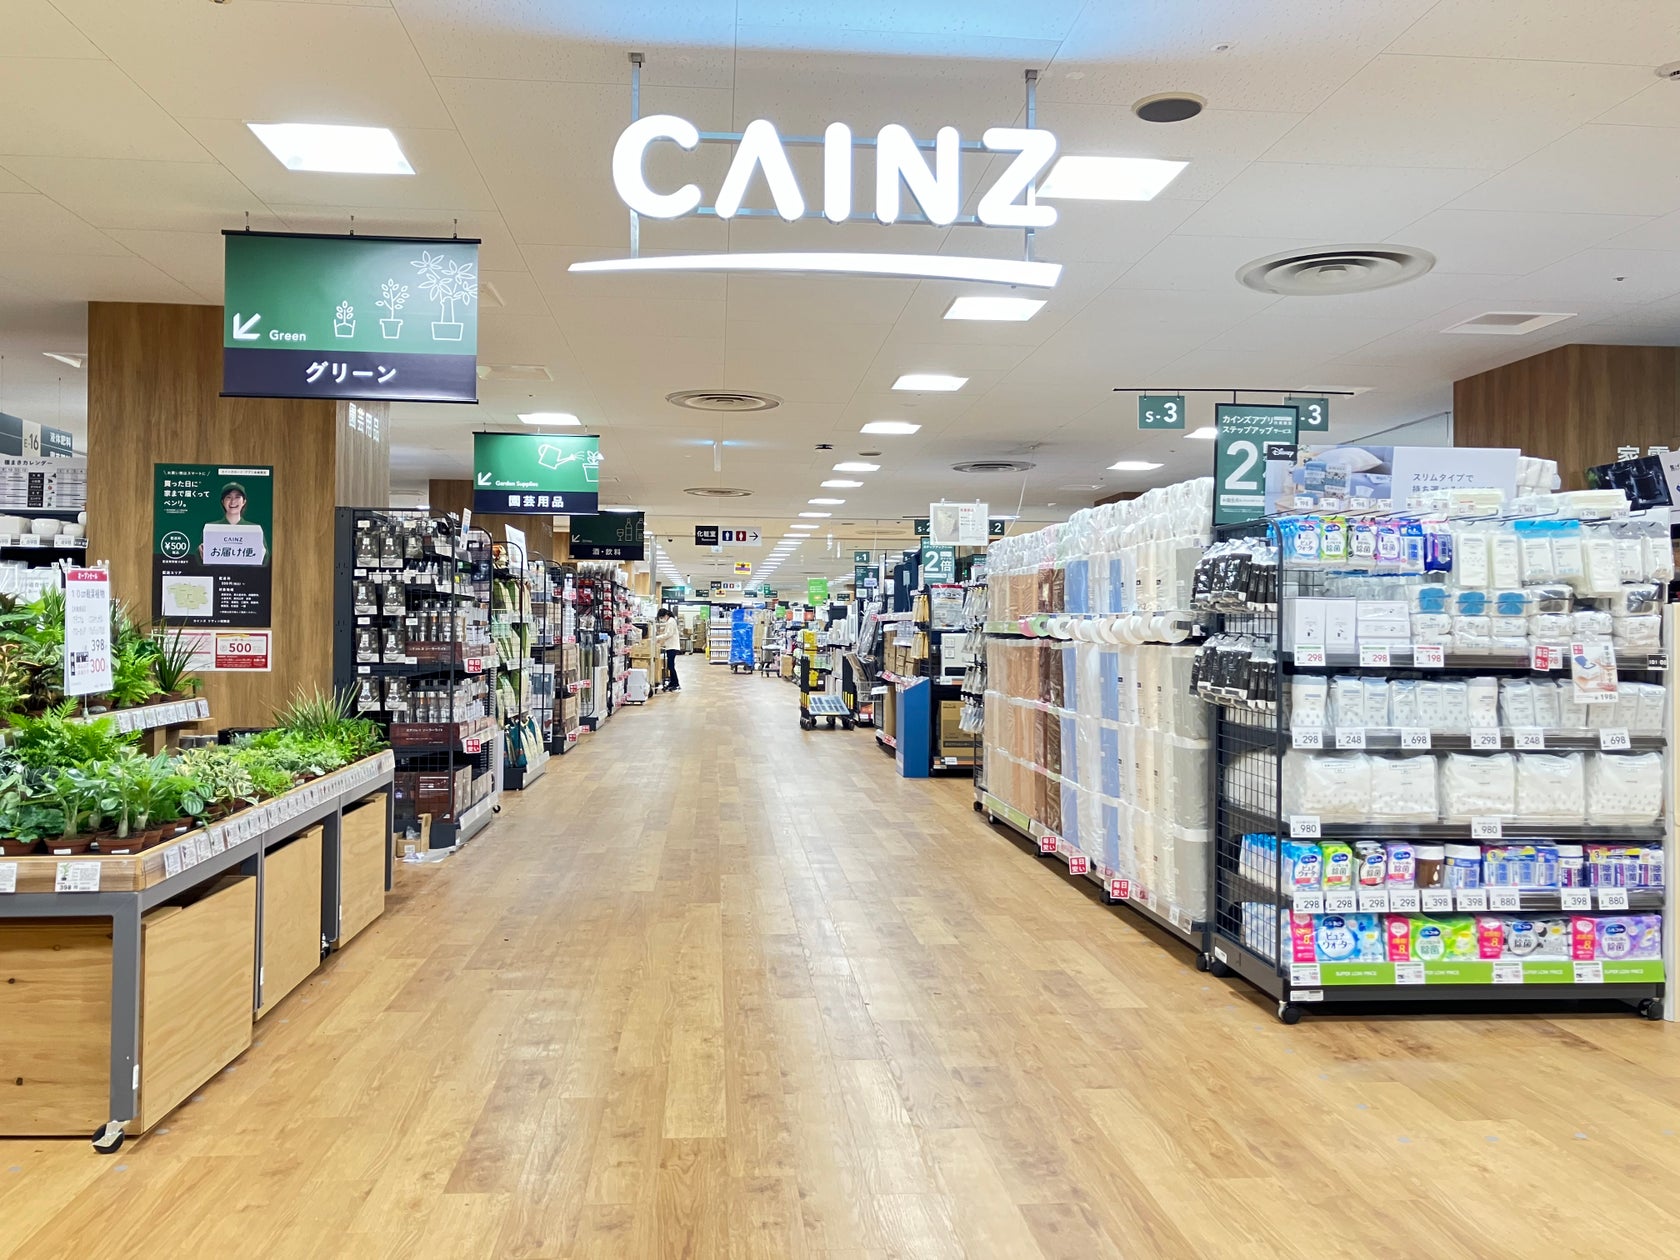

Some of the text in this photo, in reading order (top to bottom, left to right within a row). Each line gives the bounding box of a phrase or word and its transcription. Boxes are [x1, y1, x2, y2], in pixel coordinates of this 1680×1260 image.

[612, 114, 1058, 227] CAINZ
[269, 330, 307, 342] Green
[305, 361, 397, 384] グリーン
[1222, 415, 1274, 425] カインズアプリ
[1271, 447, 1295, 458] Disney
[1225, 440, 1258, 490] 2
[1413, 473, 1474, 482] スリムタイプで
[164, 480, 198, 488] 買った日に
[164, 490, 210, 498] 家まで届くって
[508, 495, 564, 508] 園芸用品
[697, 530, 716, 538] 化粧室
[165, 542, 187, 551] ¥500
[1356, 545, 1370, 553] 除菌
[210, 547, 255, 558] お届け便
[592, 548, 621, 556] 酒・飲料
[91, 639, 105, 651] 398
[229, 643, 252, 653] 500
[1536, 646, 1549, 658] 毎日
[1307, 654, 1323, 662] 298
[1372, 654, 1388, 662] 298
[1427, 654, 1441, 662] 198
[90, 658, 106, 673] 300
[1536, 658, 1549, 669] 安い
[1303, 736, 1318, 744] 298
[1346, 736, 1362, 744] 248
[1411, 736, 1427, 744] 698
[1481, 736, 1497, 744] 298
[1524, 736, 1540, 744] 248
[1610, 736, 1626, 744] 698
[1300, 824, 1317, 832] 980
[1481, 826, 1497, 834] 980
[1337, 900, 1352, 908] 298
[1369, 900, 1385, 908] 298
[1400, 899, 1416, 907] 298
[1433, 899, 1448, 907] 398
[1467, 898, 1483, 906] 398
[1500, 898, 1516, 906] 880
[1571, 897, 1587, 905] 398
[1608, 896, 1624, 904] 880
[1304, 901, 1320, 909] 298
[1326, 932, 1345, 940] ピュア
